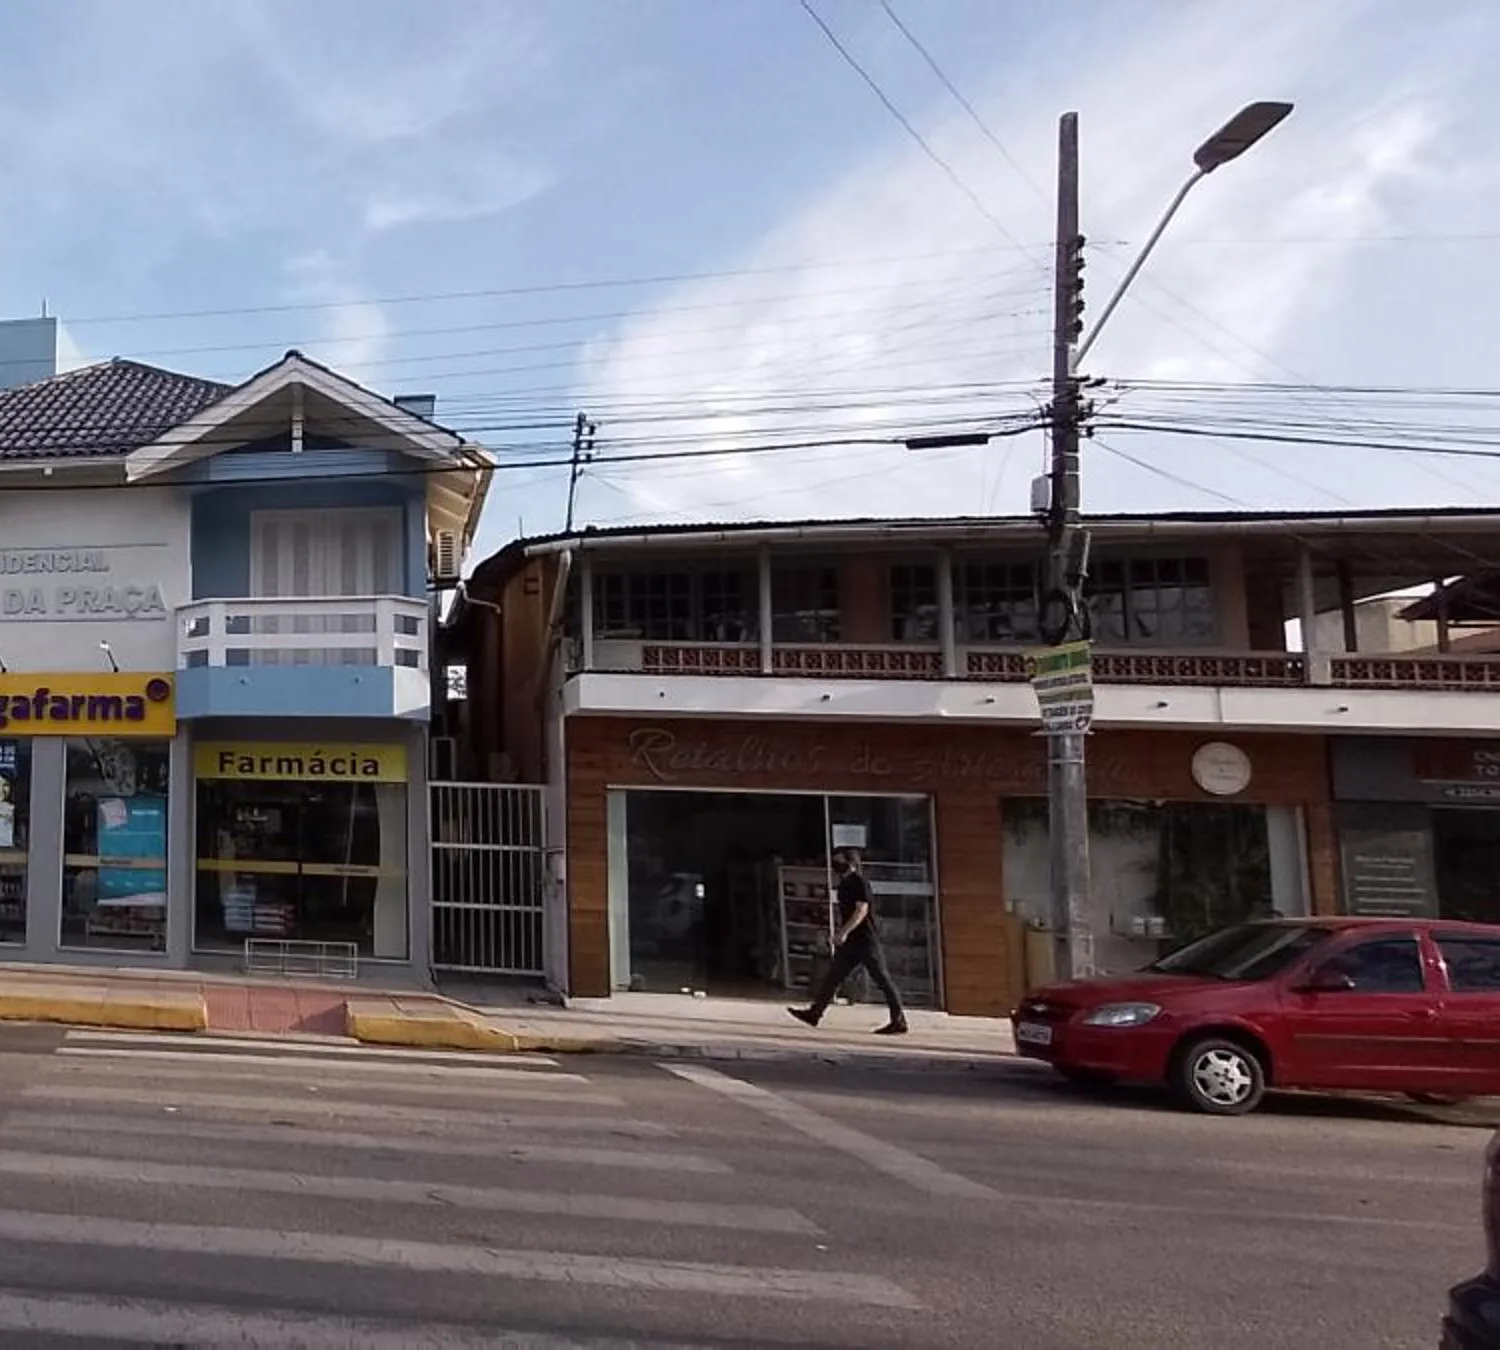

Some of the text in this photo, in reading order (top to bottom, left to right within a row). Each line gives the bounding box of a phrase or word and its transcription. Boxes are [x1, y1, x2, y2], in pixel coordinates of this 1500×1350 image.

[3, 583, 167, 619] DA PRAÇA
[219, 750, 380, 776] Farmácia
